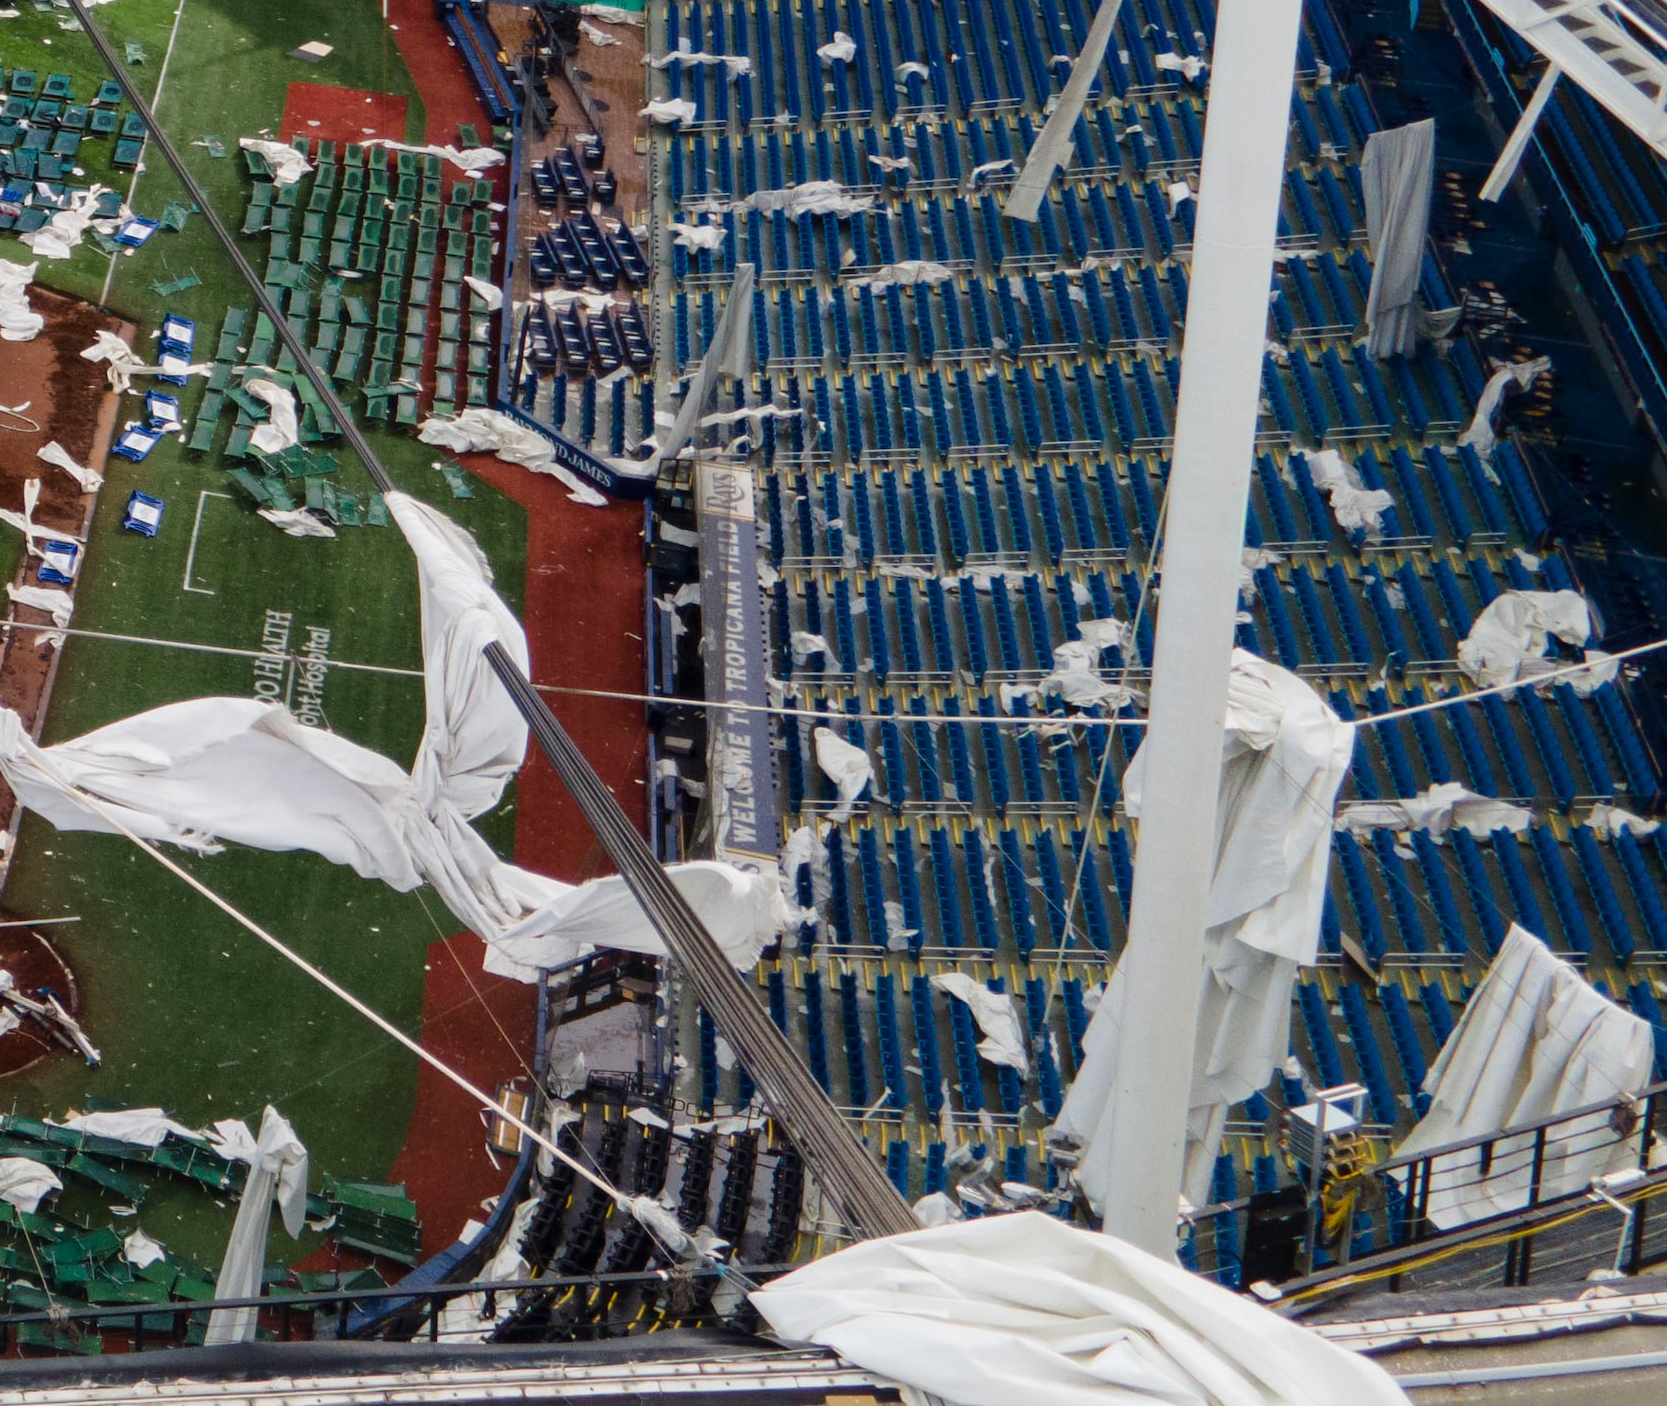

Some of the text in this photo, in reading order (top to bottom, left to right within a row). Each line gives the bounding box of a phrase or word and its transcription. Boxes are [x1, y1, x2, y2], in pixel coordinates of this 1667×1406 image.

[567, 452, 612, 488] JAMES
[717, 520, 740, 576] FIELD
[724, 581, 747, 689] TROPICANA
